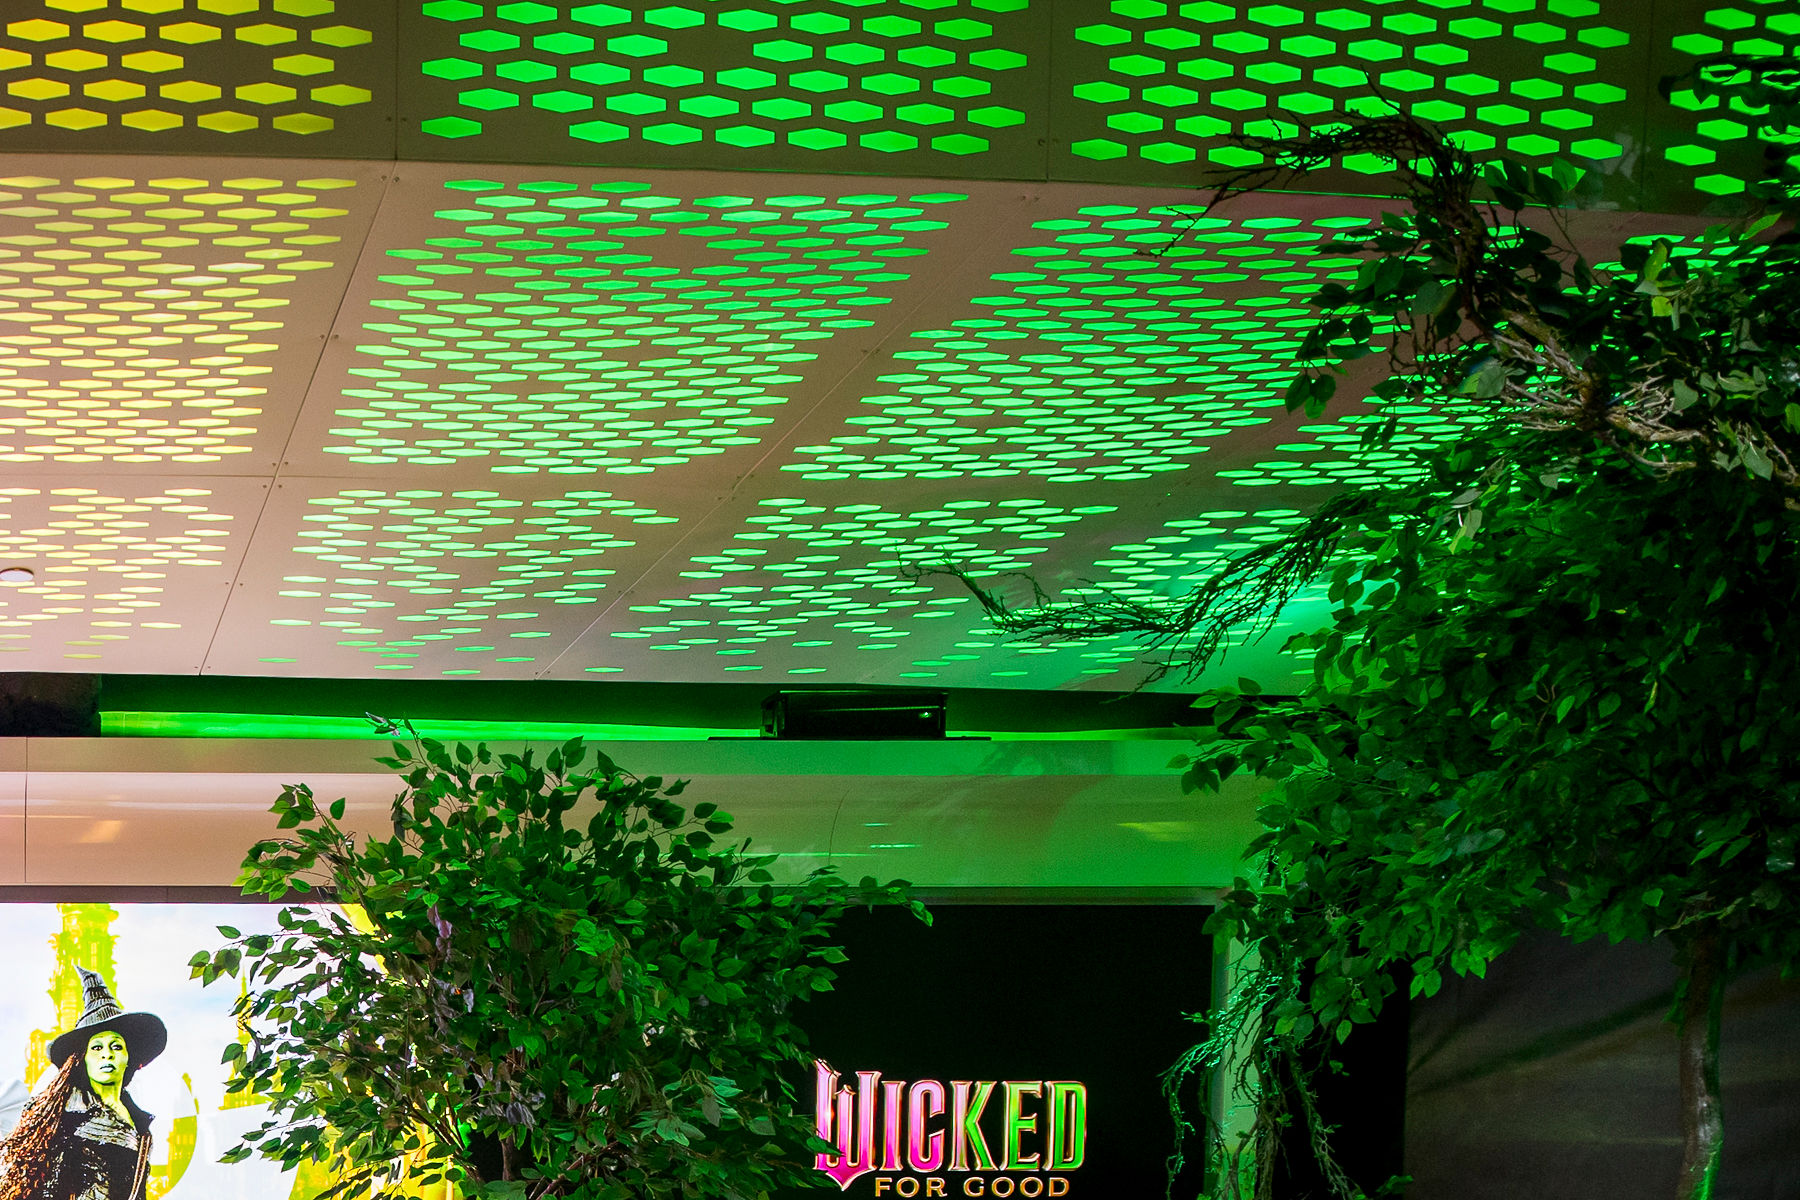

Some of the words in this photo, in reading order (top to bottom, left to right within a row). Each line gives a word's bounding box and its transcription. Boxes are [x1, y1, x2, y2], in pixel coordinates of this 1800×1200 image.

[812, 1058, 1087, 1191] WICKED
[874, 1177, 947, 1197] FOR
[963, 1176, 1070, 1197] GOOD
